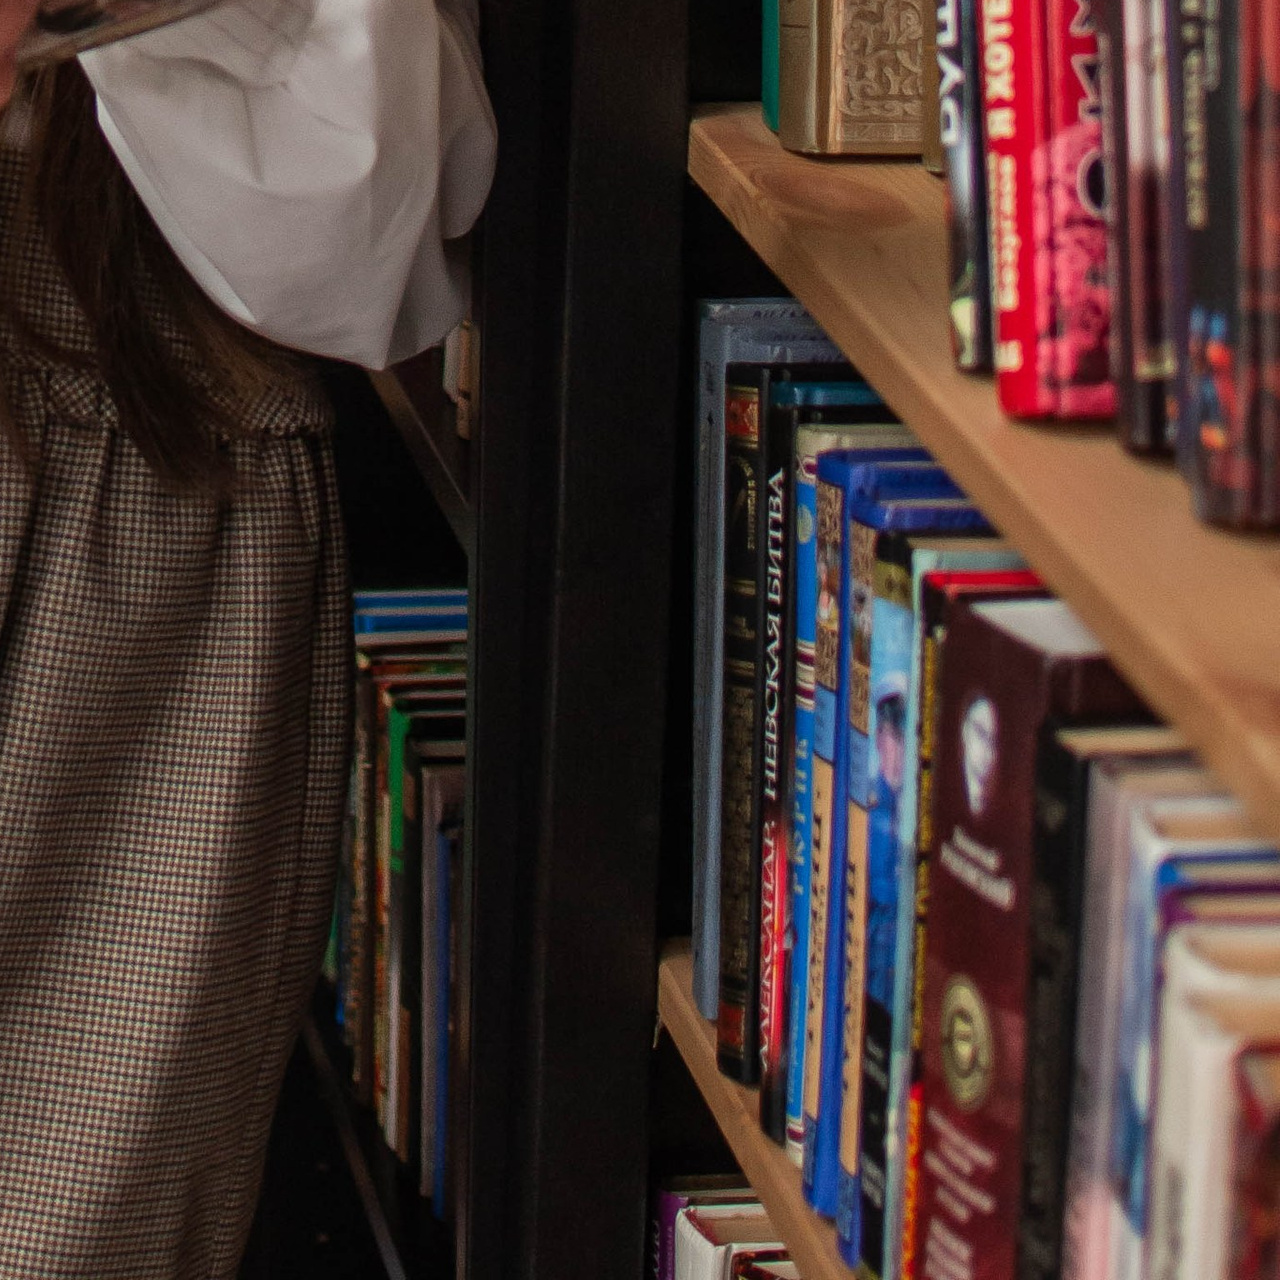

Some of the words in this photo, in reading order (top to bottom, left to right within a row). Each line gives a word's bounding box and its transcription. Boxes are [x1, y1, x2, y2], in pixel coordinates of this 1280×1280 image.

[986, 109, 1018, 141] Я
[766, 468, 783, 603] БИТВА
[764, 614, 780, 801] НЕВСКАЯ
